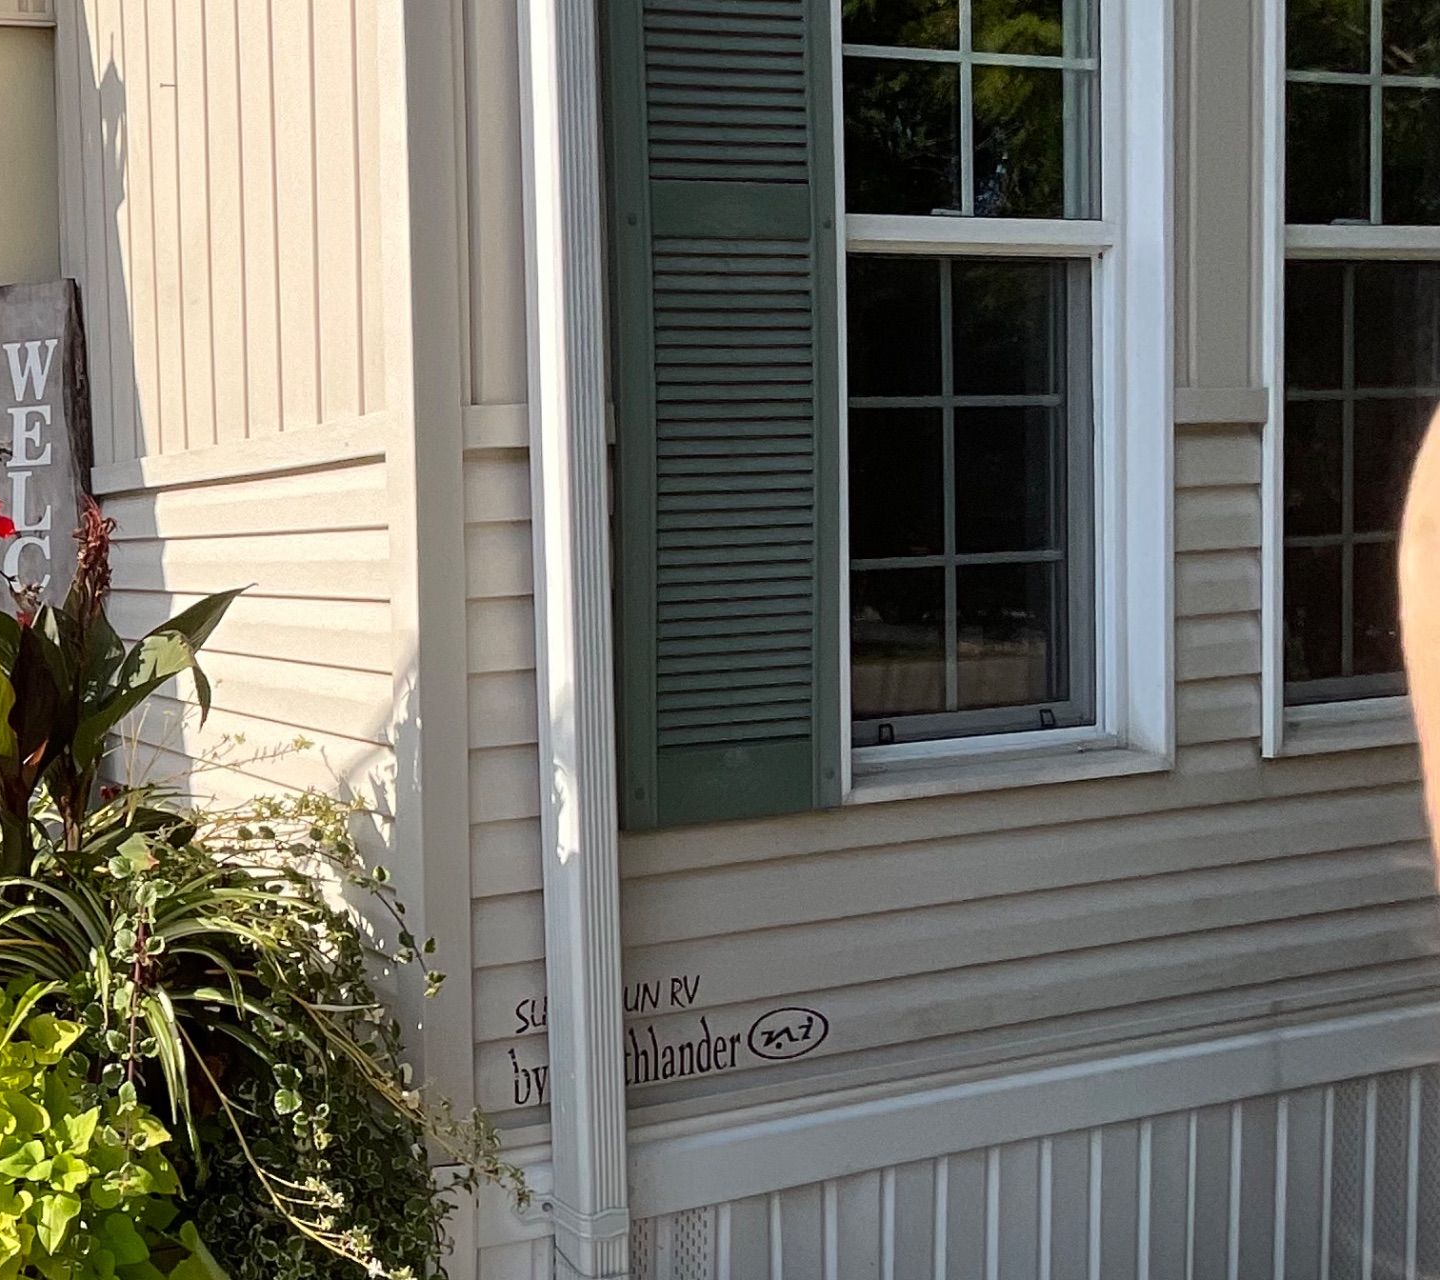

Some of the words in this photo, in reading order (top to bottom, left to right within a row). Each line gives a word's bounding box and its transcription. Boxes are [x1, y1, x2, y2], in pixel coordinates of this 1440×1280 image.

[2, 339, 58, 594] WELC
[515, 995, 548, 1035] SU
[623, 980, 660, 1012] UN
[670, 975, 701, 1009] RV
[624, 1016, 741, 1086] thlander
